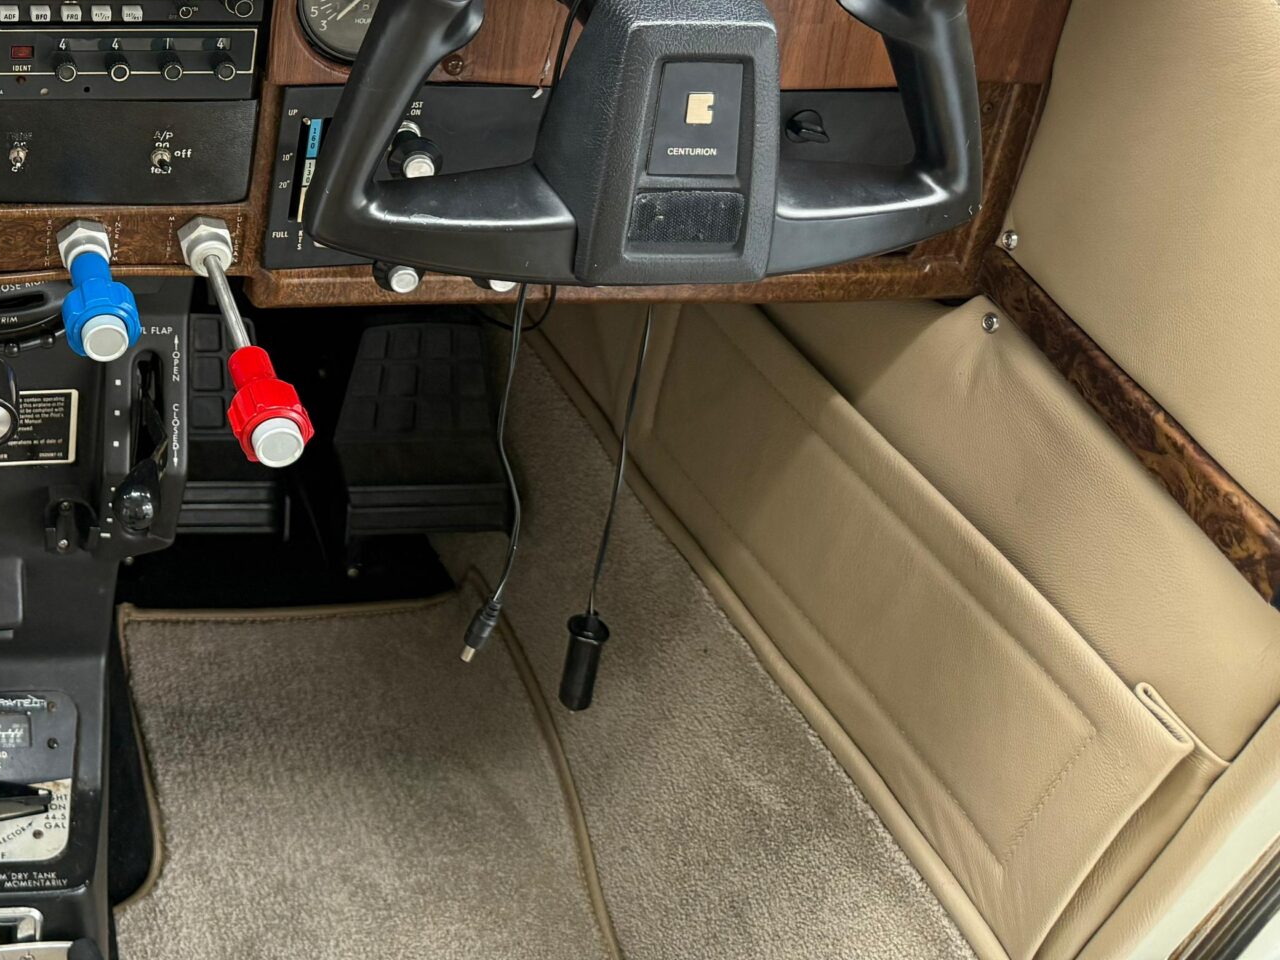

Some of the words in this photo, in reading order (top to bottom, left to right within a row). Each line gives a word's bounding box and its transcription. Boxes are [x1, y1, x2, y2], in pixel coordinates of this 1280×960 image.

[153, 130, 173, 140] A/P
[667, 147, 717, 156] CENTURION
[151, 326, 173, 335] FLAP
[172, 351, 181, 382] OPEN
[172, 403, 180, 450] CLOSED
[11, 872, 28, 880] DRY
[4, 878, 67, 888] MOMENTARILY
